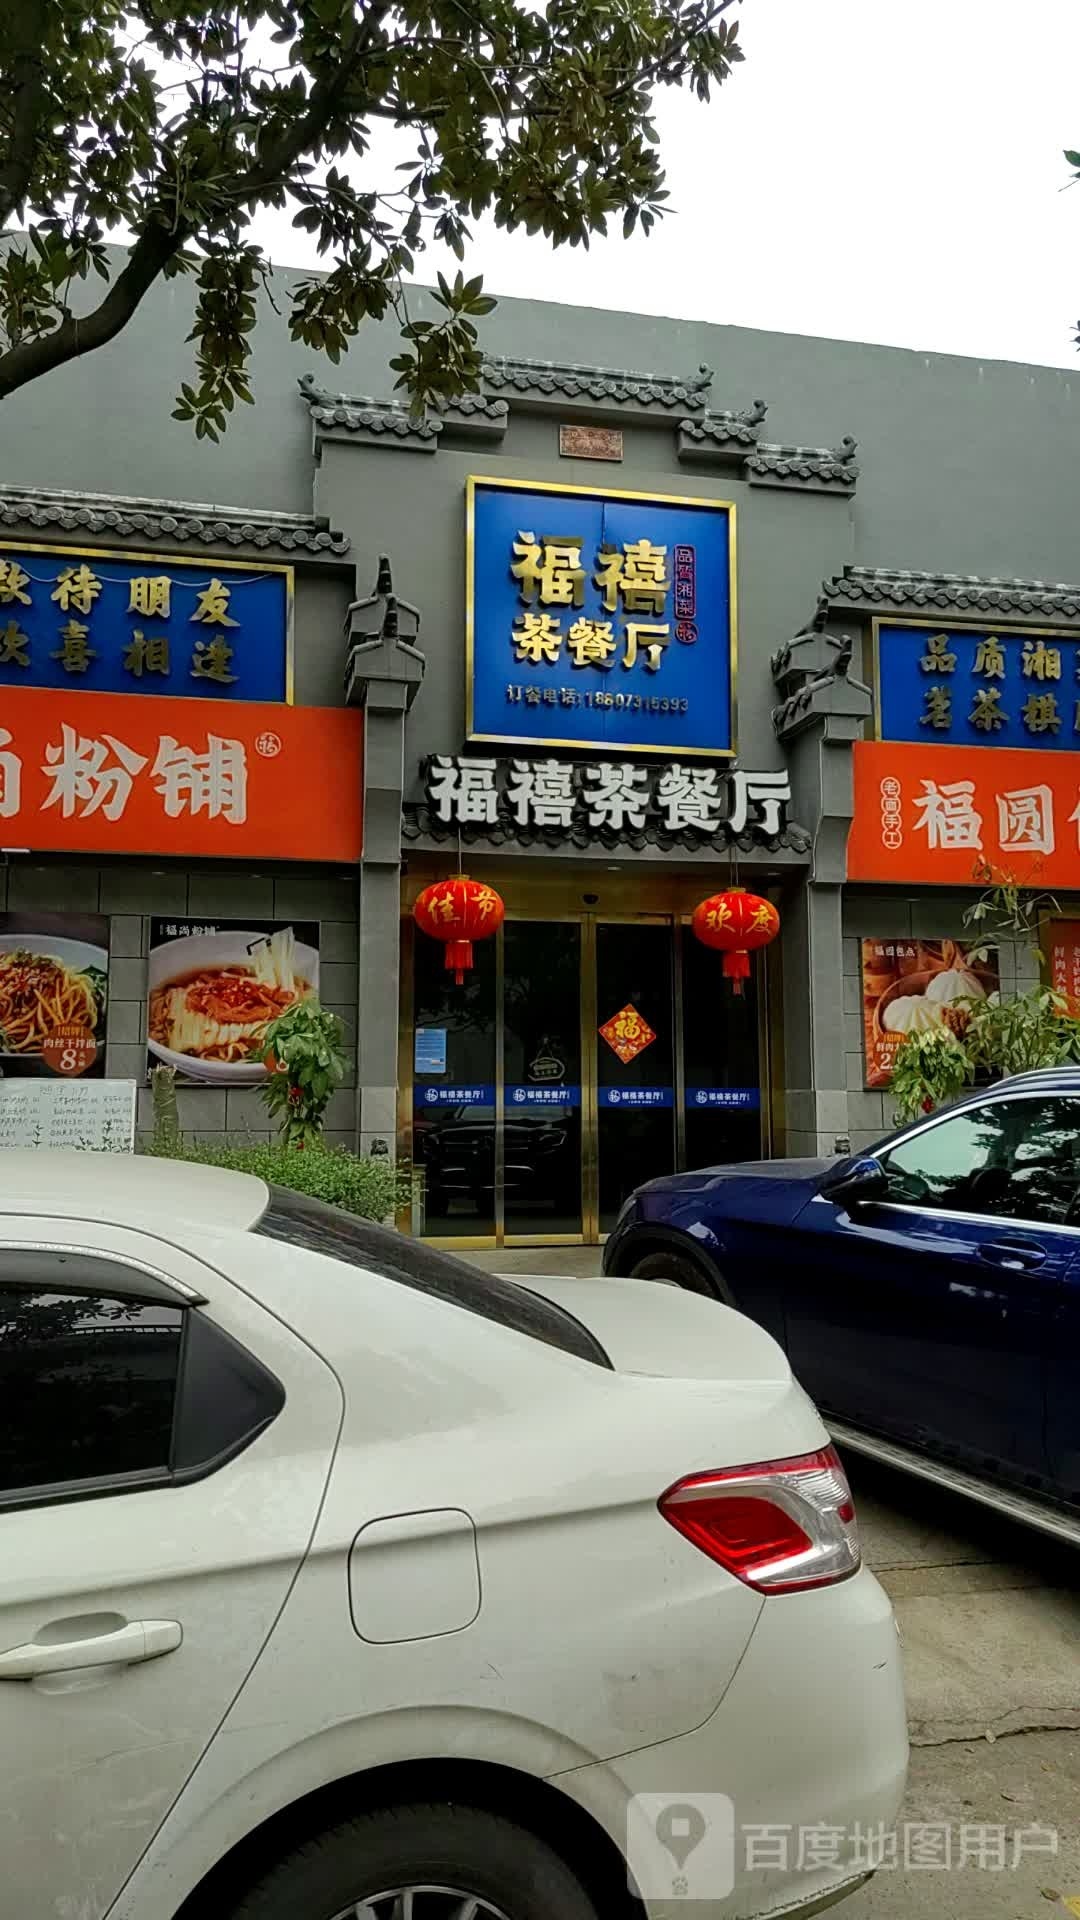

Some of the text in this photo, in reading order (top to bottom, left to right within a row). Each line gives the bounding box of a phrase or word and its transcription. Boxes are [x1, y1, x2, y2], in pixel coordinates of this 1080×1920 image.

[511, 530, 671, 615] 福禧
[512, 613, 670, 671] 茶餐厅
[919, 633, 1080, 681] 品质湘
[919, 686, 1080, 734] 茗茶棋
[0, 722, 248, 824] 粉铺
[429, 754, 791, 835] 福禧茶餐厅
[912, 779, 1080, 855] 福圆
[614, 1011, 641, 1039] 福
[60, 1049, 77, 1070] 8
